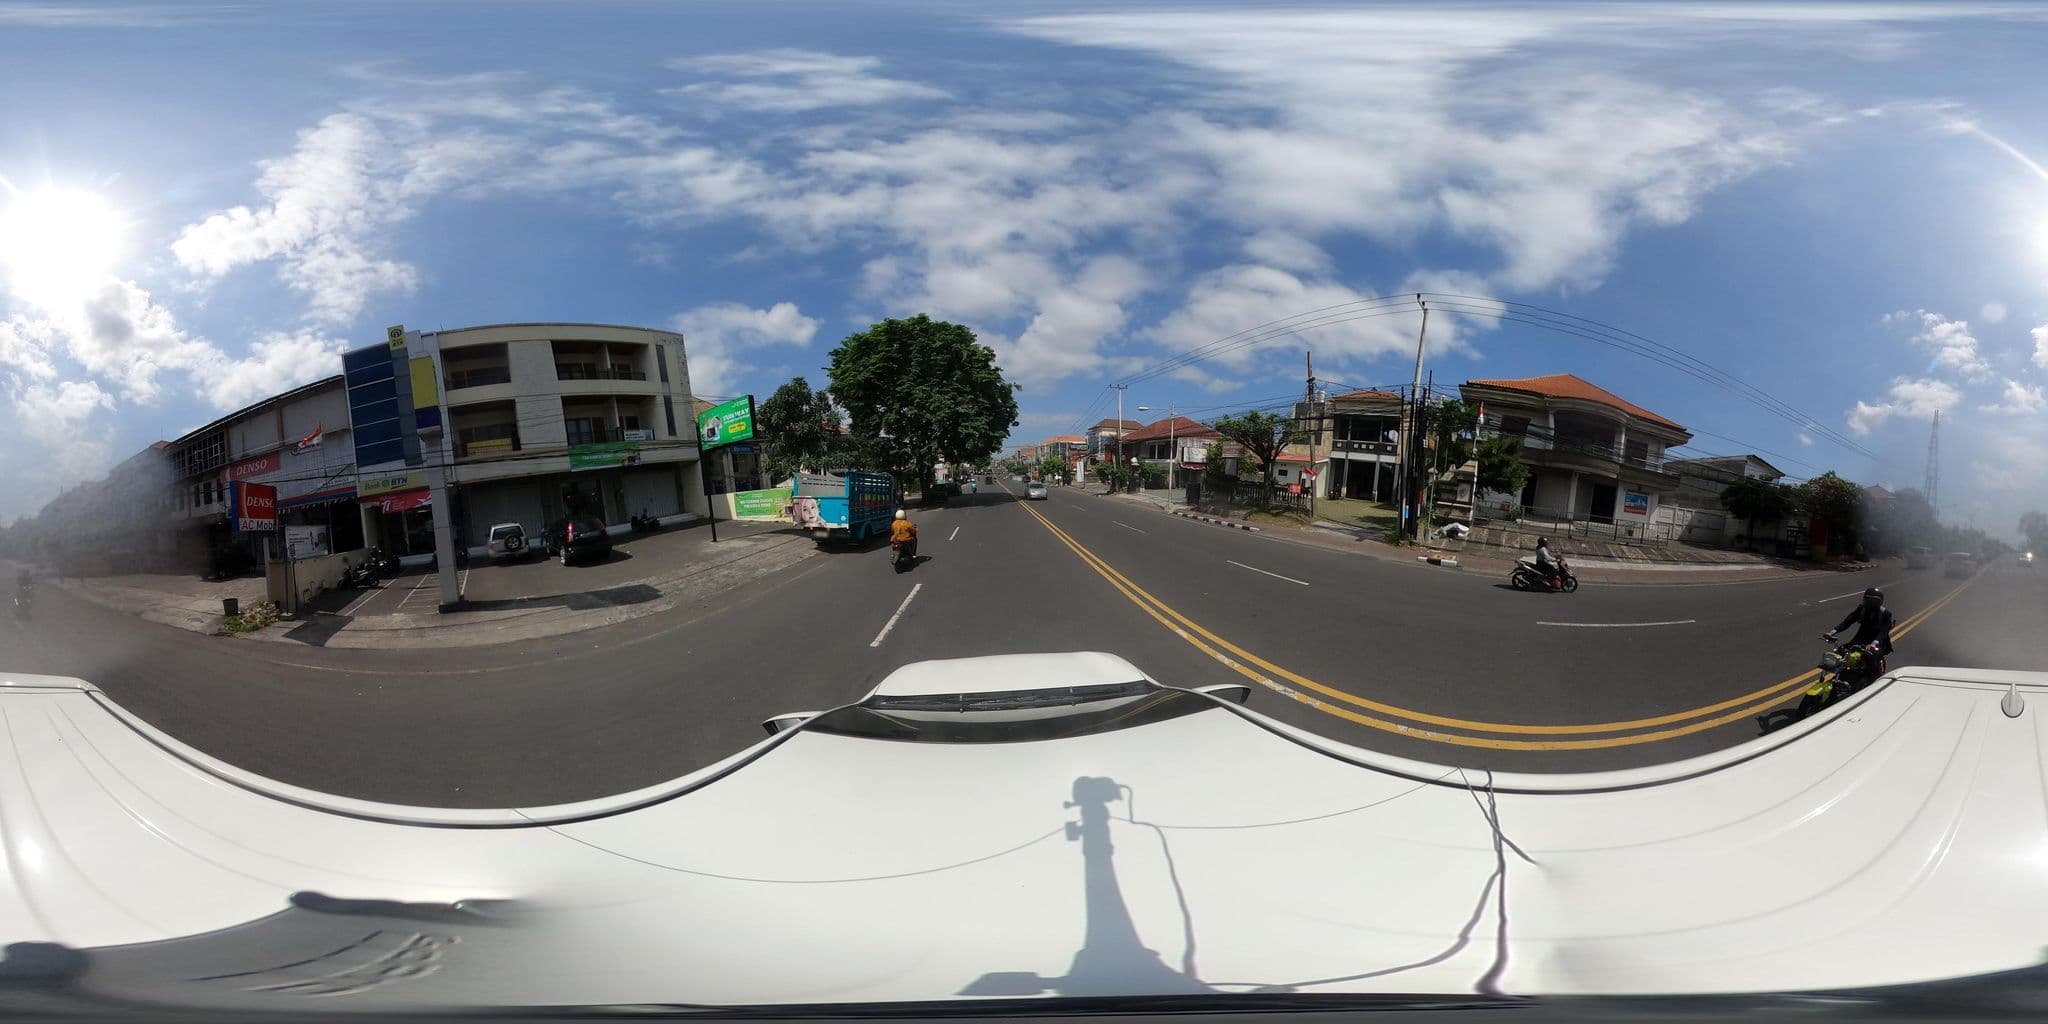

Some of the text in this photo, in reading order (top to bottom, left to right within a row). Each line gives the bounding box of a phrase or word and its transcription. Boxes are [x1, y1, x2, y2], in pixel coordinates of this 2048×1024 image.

[236, 459, 268, 476] DENSO
[364, 477, 408, 491] Bank BTN
[242, 519, 254, 530] AC
